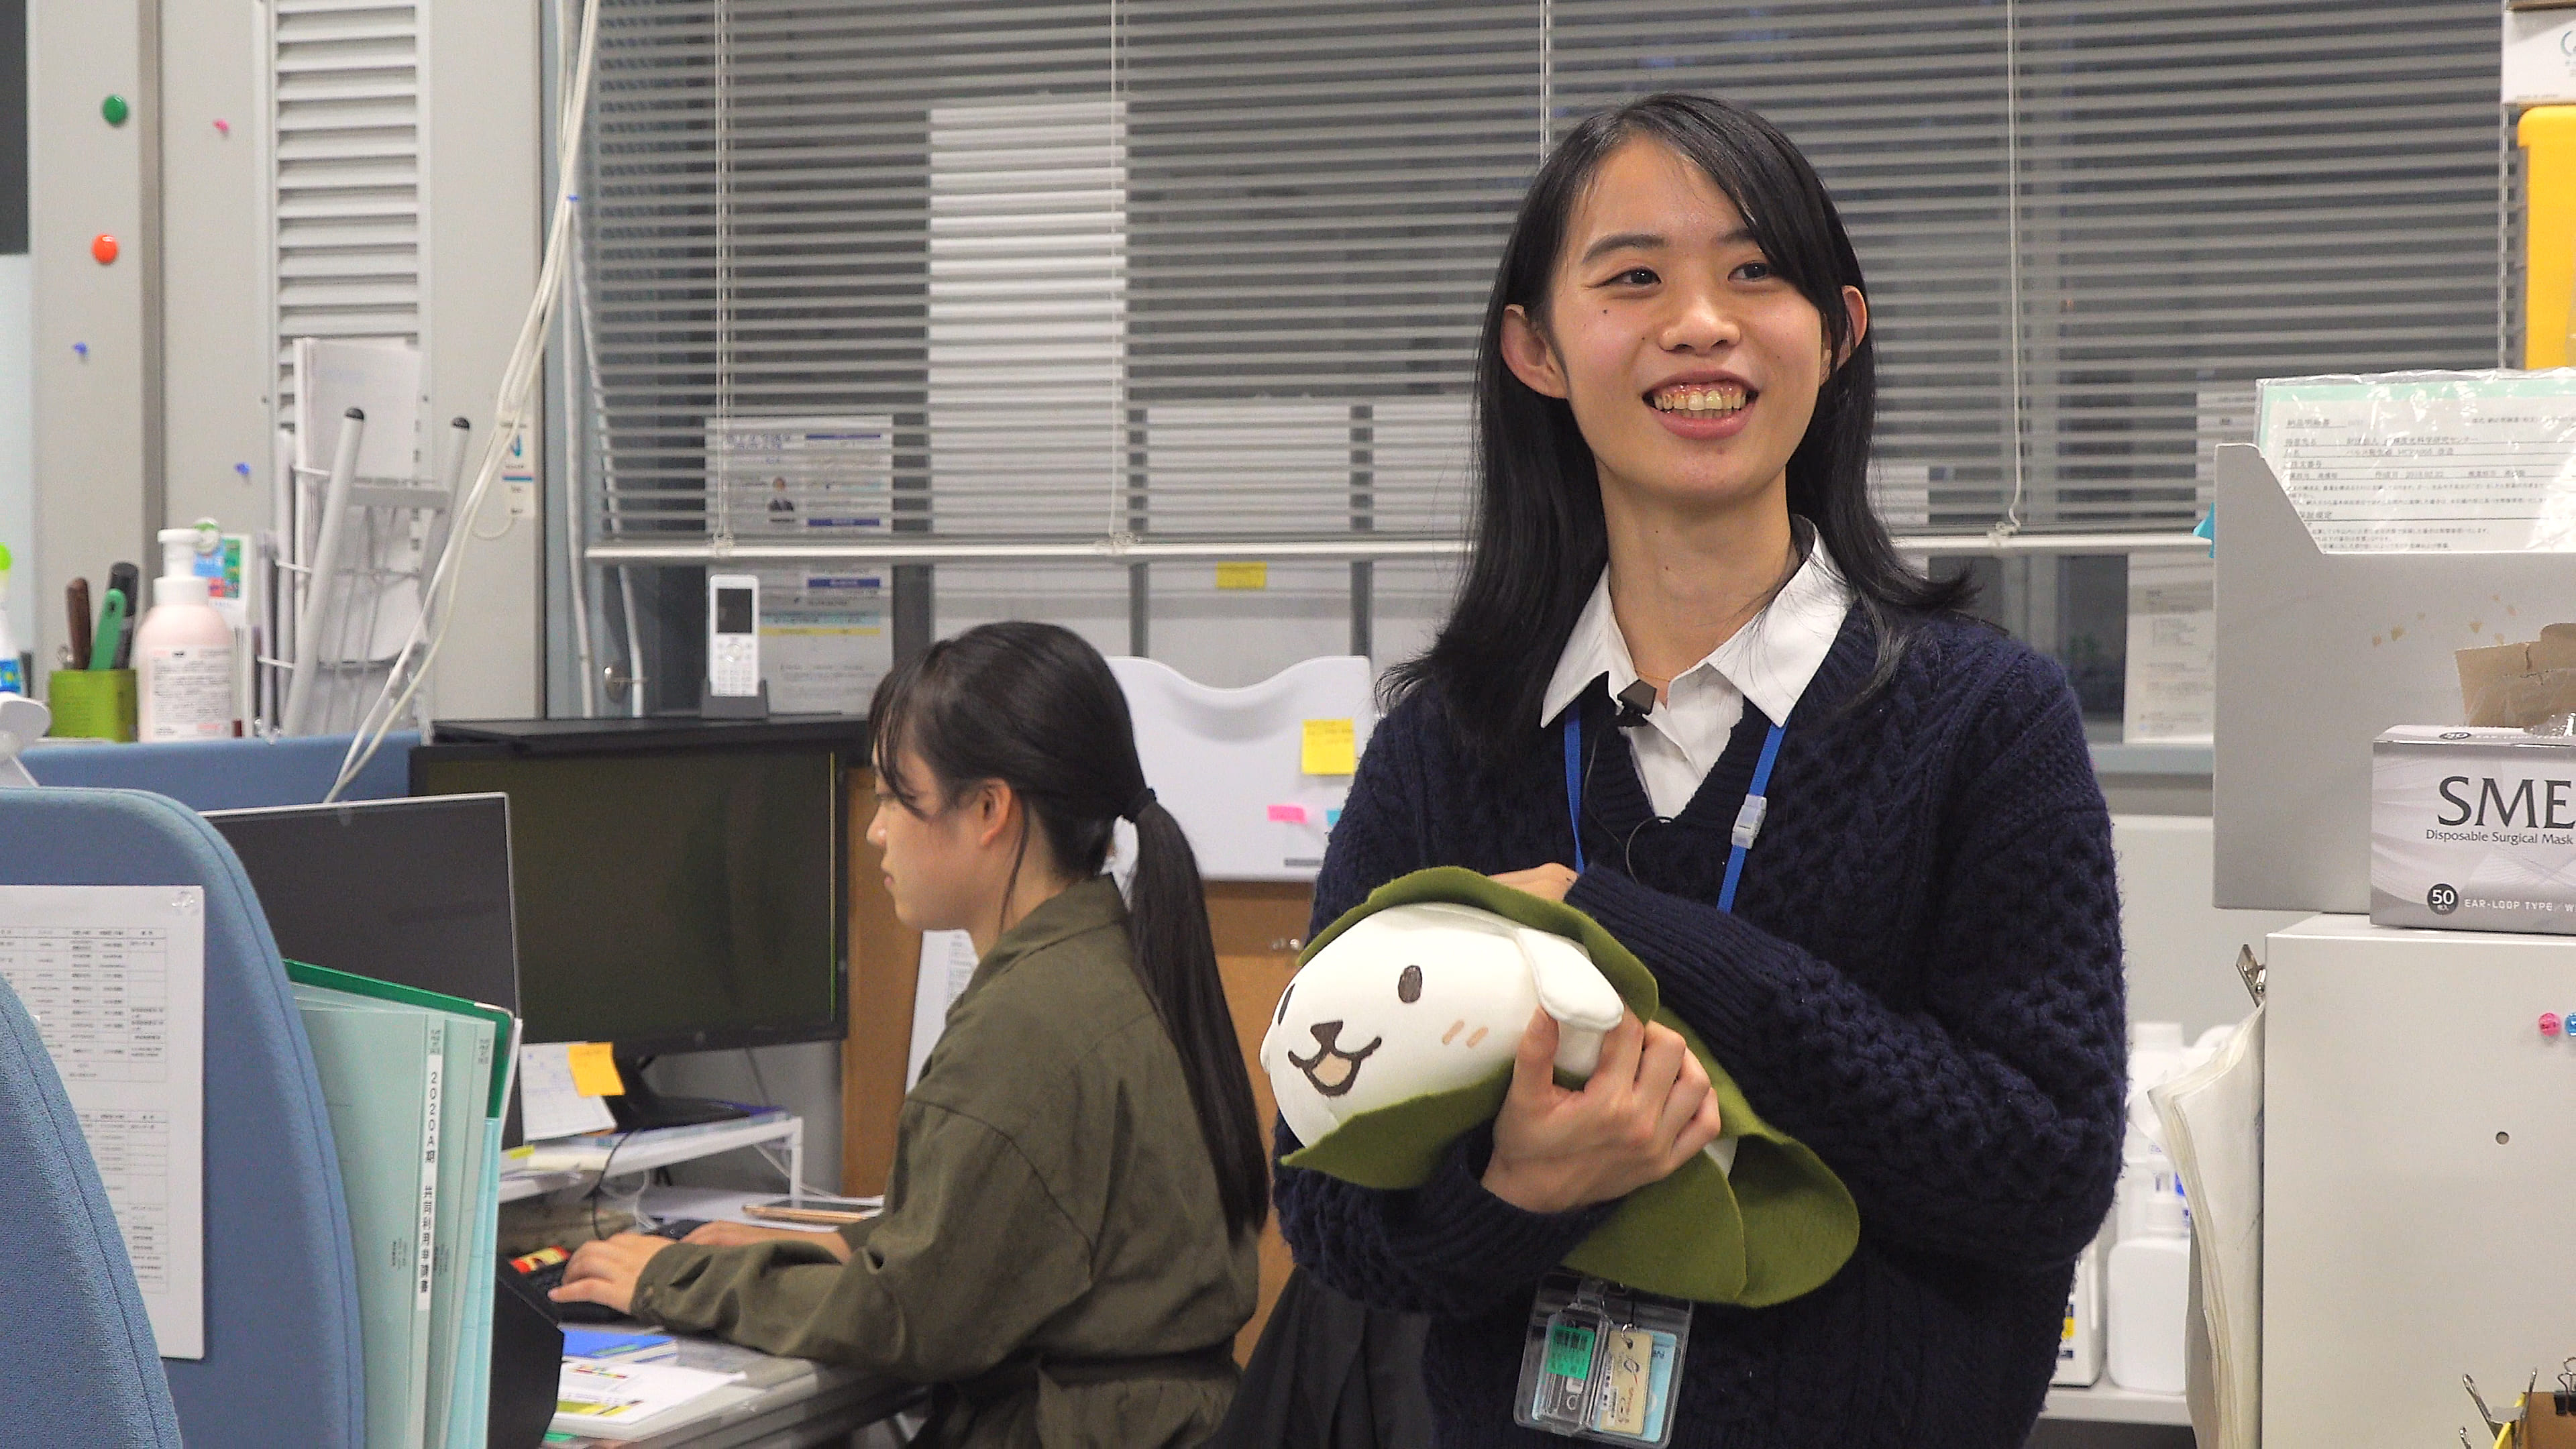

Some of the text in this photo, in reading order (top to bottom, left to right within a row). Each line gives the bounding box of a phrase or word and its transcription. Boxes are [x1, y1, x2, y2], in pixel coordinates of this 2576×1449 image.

[2438, 775, 2575, 829] SME
[2426, 829, 2573, 845] Disposable Surgical Mask
[2432, 890, 2455, 904] 50
[2464, 899, 2520, 910] EAR-LOOP
[2524, 901, 2553, 911] TYPE
[425, 1071, 437, 1164] 2020A期
